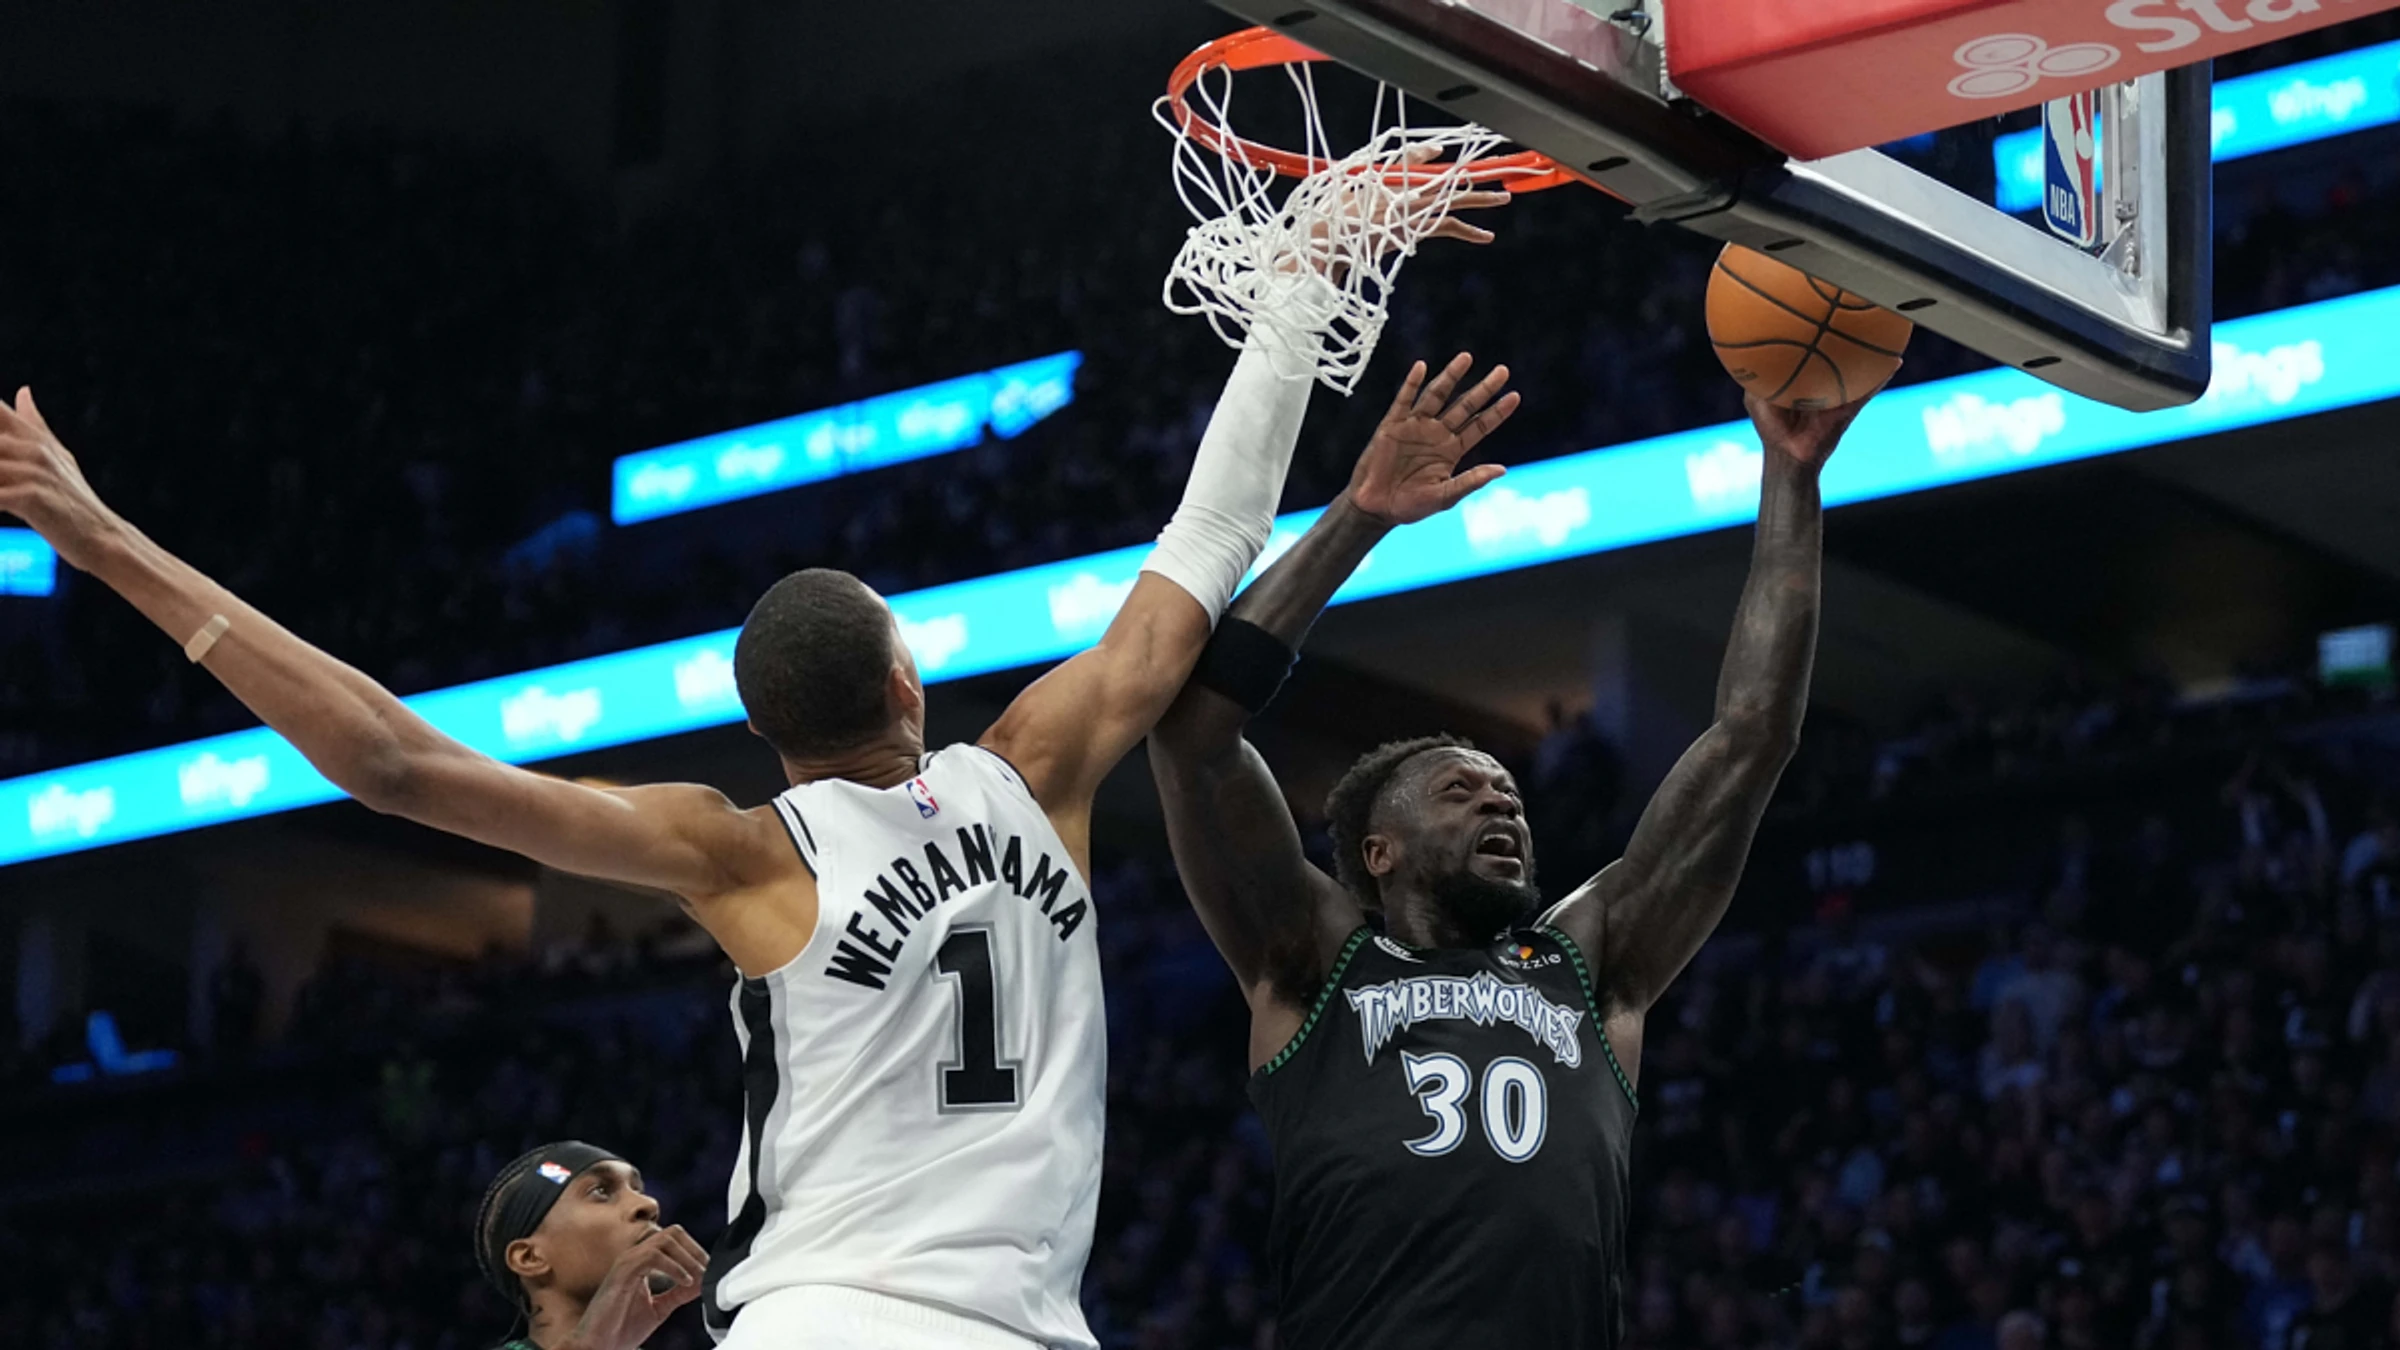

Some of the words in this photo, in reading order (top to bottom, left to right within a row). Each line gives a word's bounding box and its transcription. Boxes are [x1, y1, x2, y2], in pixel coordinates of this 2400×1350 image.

[2104, 0, 2362, 53] Sta
[2050, 183, 2077, 227] NBA
[824, 823, 1088, 991] WEMBANAMA
[933, 920, 1024, 1115] 1
[1343, 969, 1585, 1069] TIMBERWOLVES
[1400, 1050, 1547, 1163] 30
